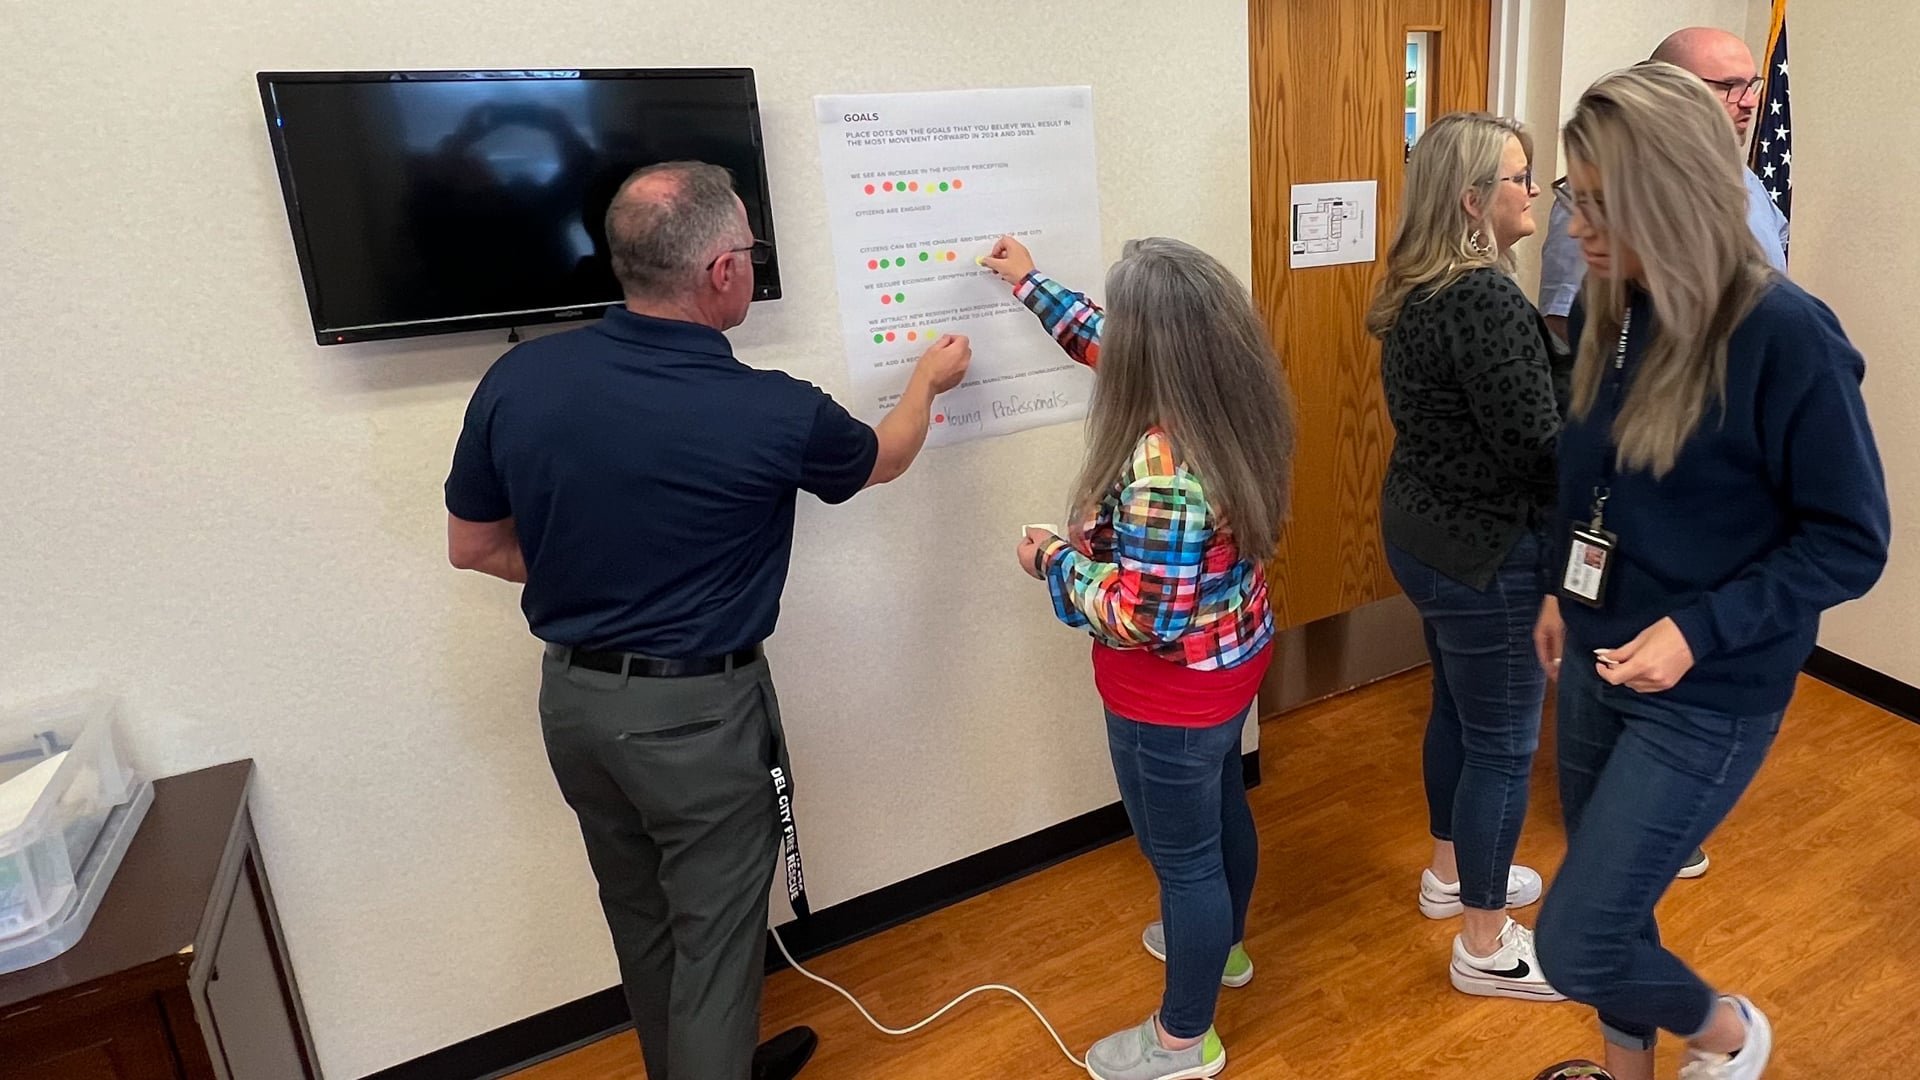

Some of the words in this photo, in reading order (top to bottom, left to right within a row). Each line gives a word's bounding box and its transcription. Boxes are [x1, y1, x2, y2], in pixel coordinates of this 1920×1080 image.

[844, 112, 879, 123] GOALS
[846, 130, 870, 139] PLACE
[873, 128, 893, 138] DOTS
[895, 128, 908, 137] ON
[910, 127, 925, 136] THE
[926, 125, 951, 135] GOALS
[953, 124, 972, 133] THAT
[974, 123, 989, 132] YOU
[991, 122, 1018, 131] BELIEVE
[1020, 121, 1035, 130] WILL
[1038, 119, 1062, 129] RESULT
[1064, 119, 1071, 128] IN
[889, 135, 931, 145] MOVEMENT
[933, 132, 970, 143] FORWARD
[944, 406, 983, 430] Young
[770, 767, 786, 794] DEL
[778, 796, 791, 823] CITY
[784, 825, 796, 853] FIRE
[786, 854, 799, 901] RESCUE
